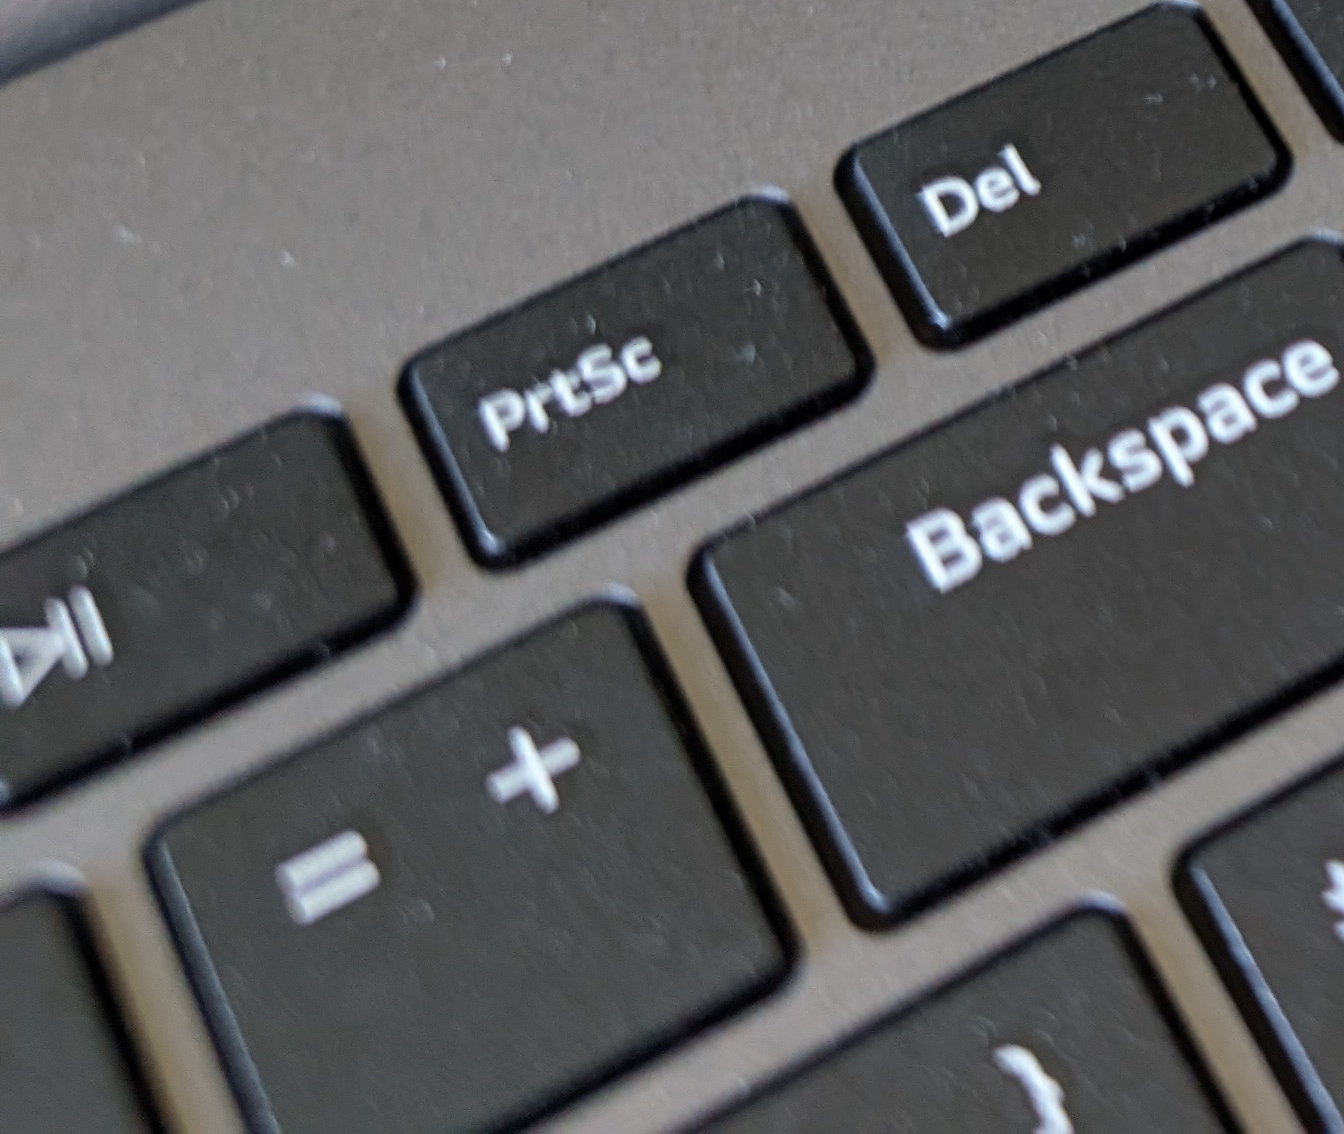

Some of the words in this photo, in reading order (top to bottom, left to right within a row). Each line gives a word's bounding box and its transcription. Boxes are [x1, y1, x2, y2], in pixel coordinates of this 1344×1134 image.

[918, 143, 1042, 239] Del
[478, 336, 662, 453] PrtSc
[904, 337, 1341, 594] Backspace
[487, 726, 581, 813] +
[277, 830, 381, 925] =
